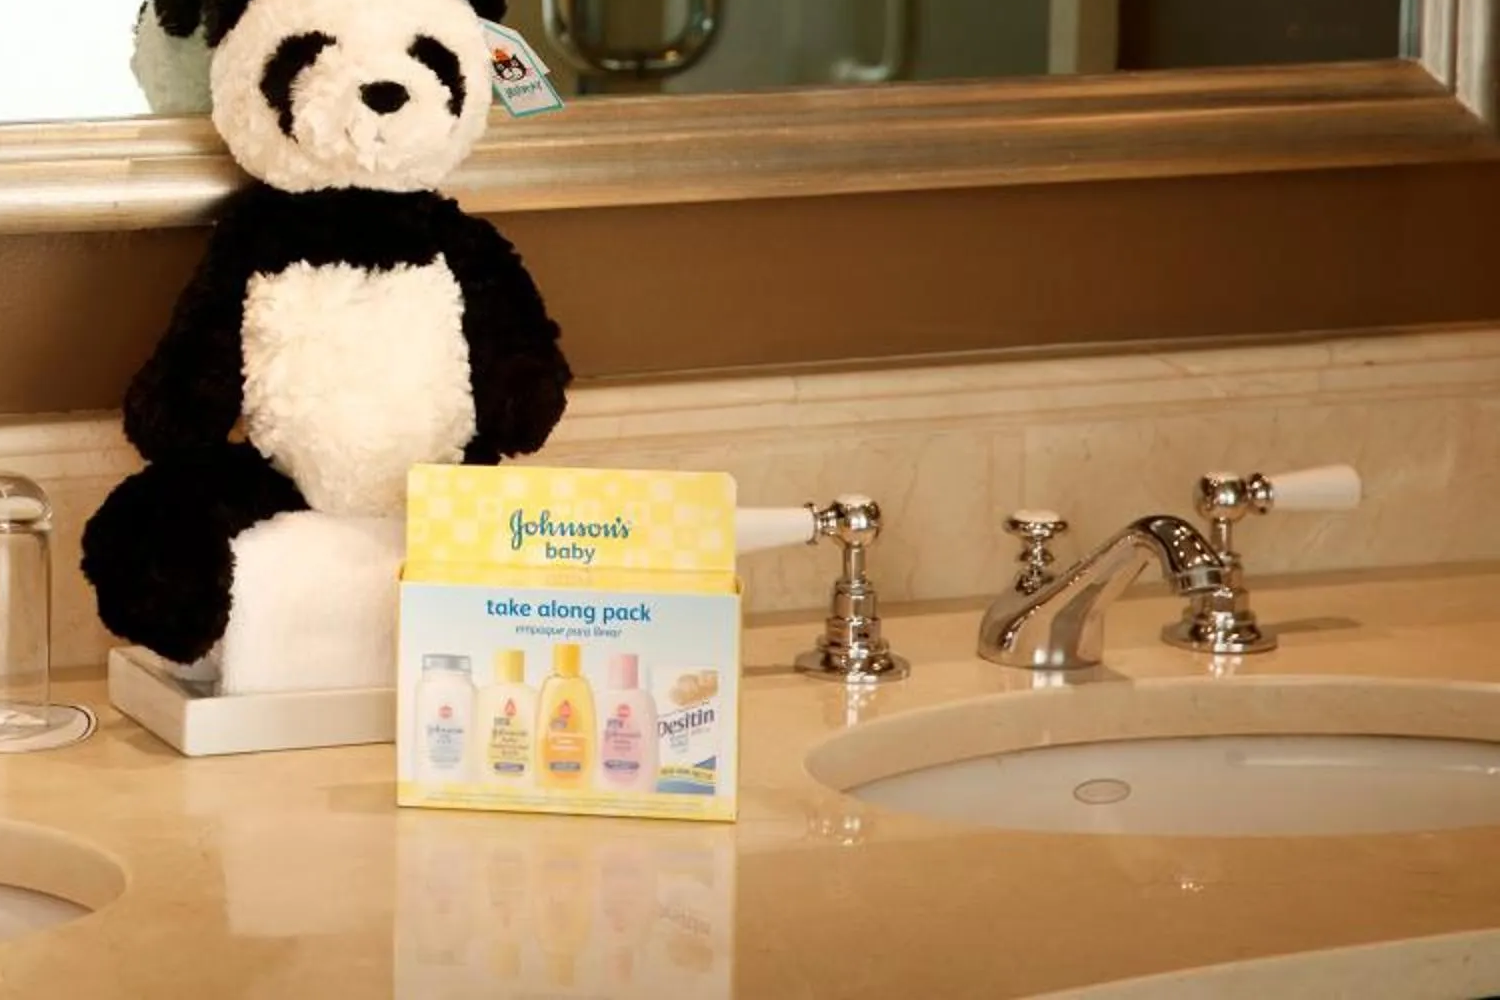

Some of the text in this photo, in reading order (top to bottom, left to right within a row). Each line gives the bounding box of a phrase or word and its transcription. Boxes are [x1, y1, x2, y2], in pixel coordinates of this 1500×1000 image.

[509, 508, 630, 550] Johnson's
[545, 542, 596, 564] baby
[486, 598, 651, 624] take along pack
[657, 707, 715, 737] Desitin
